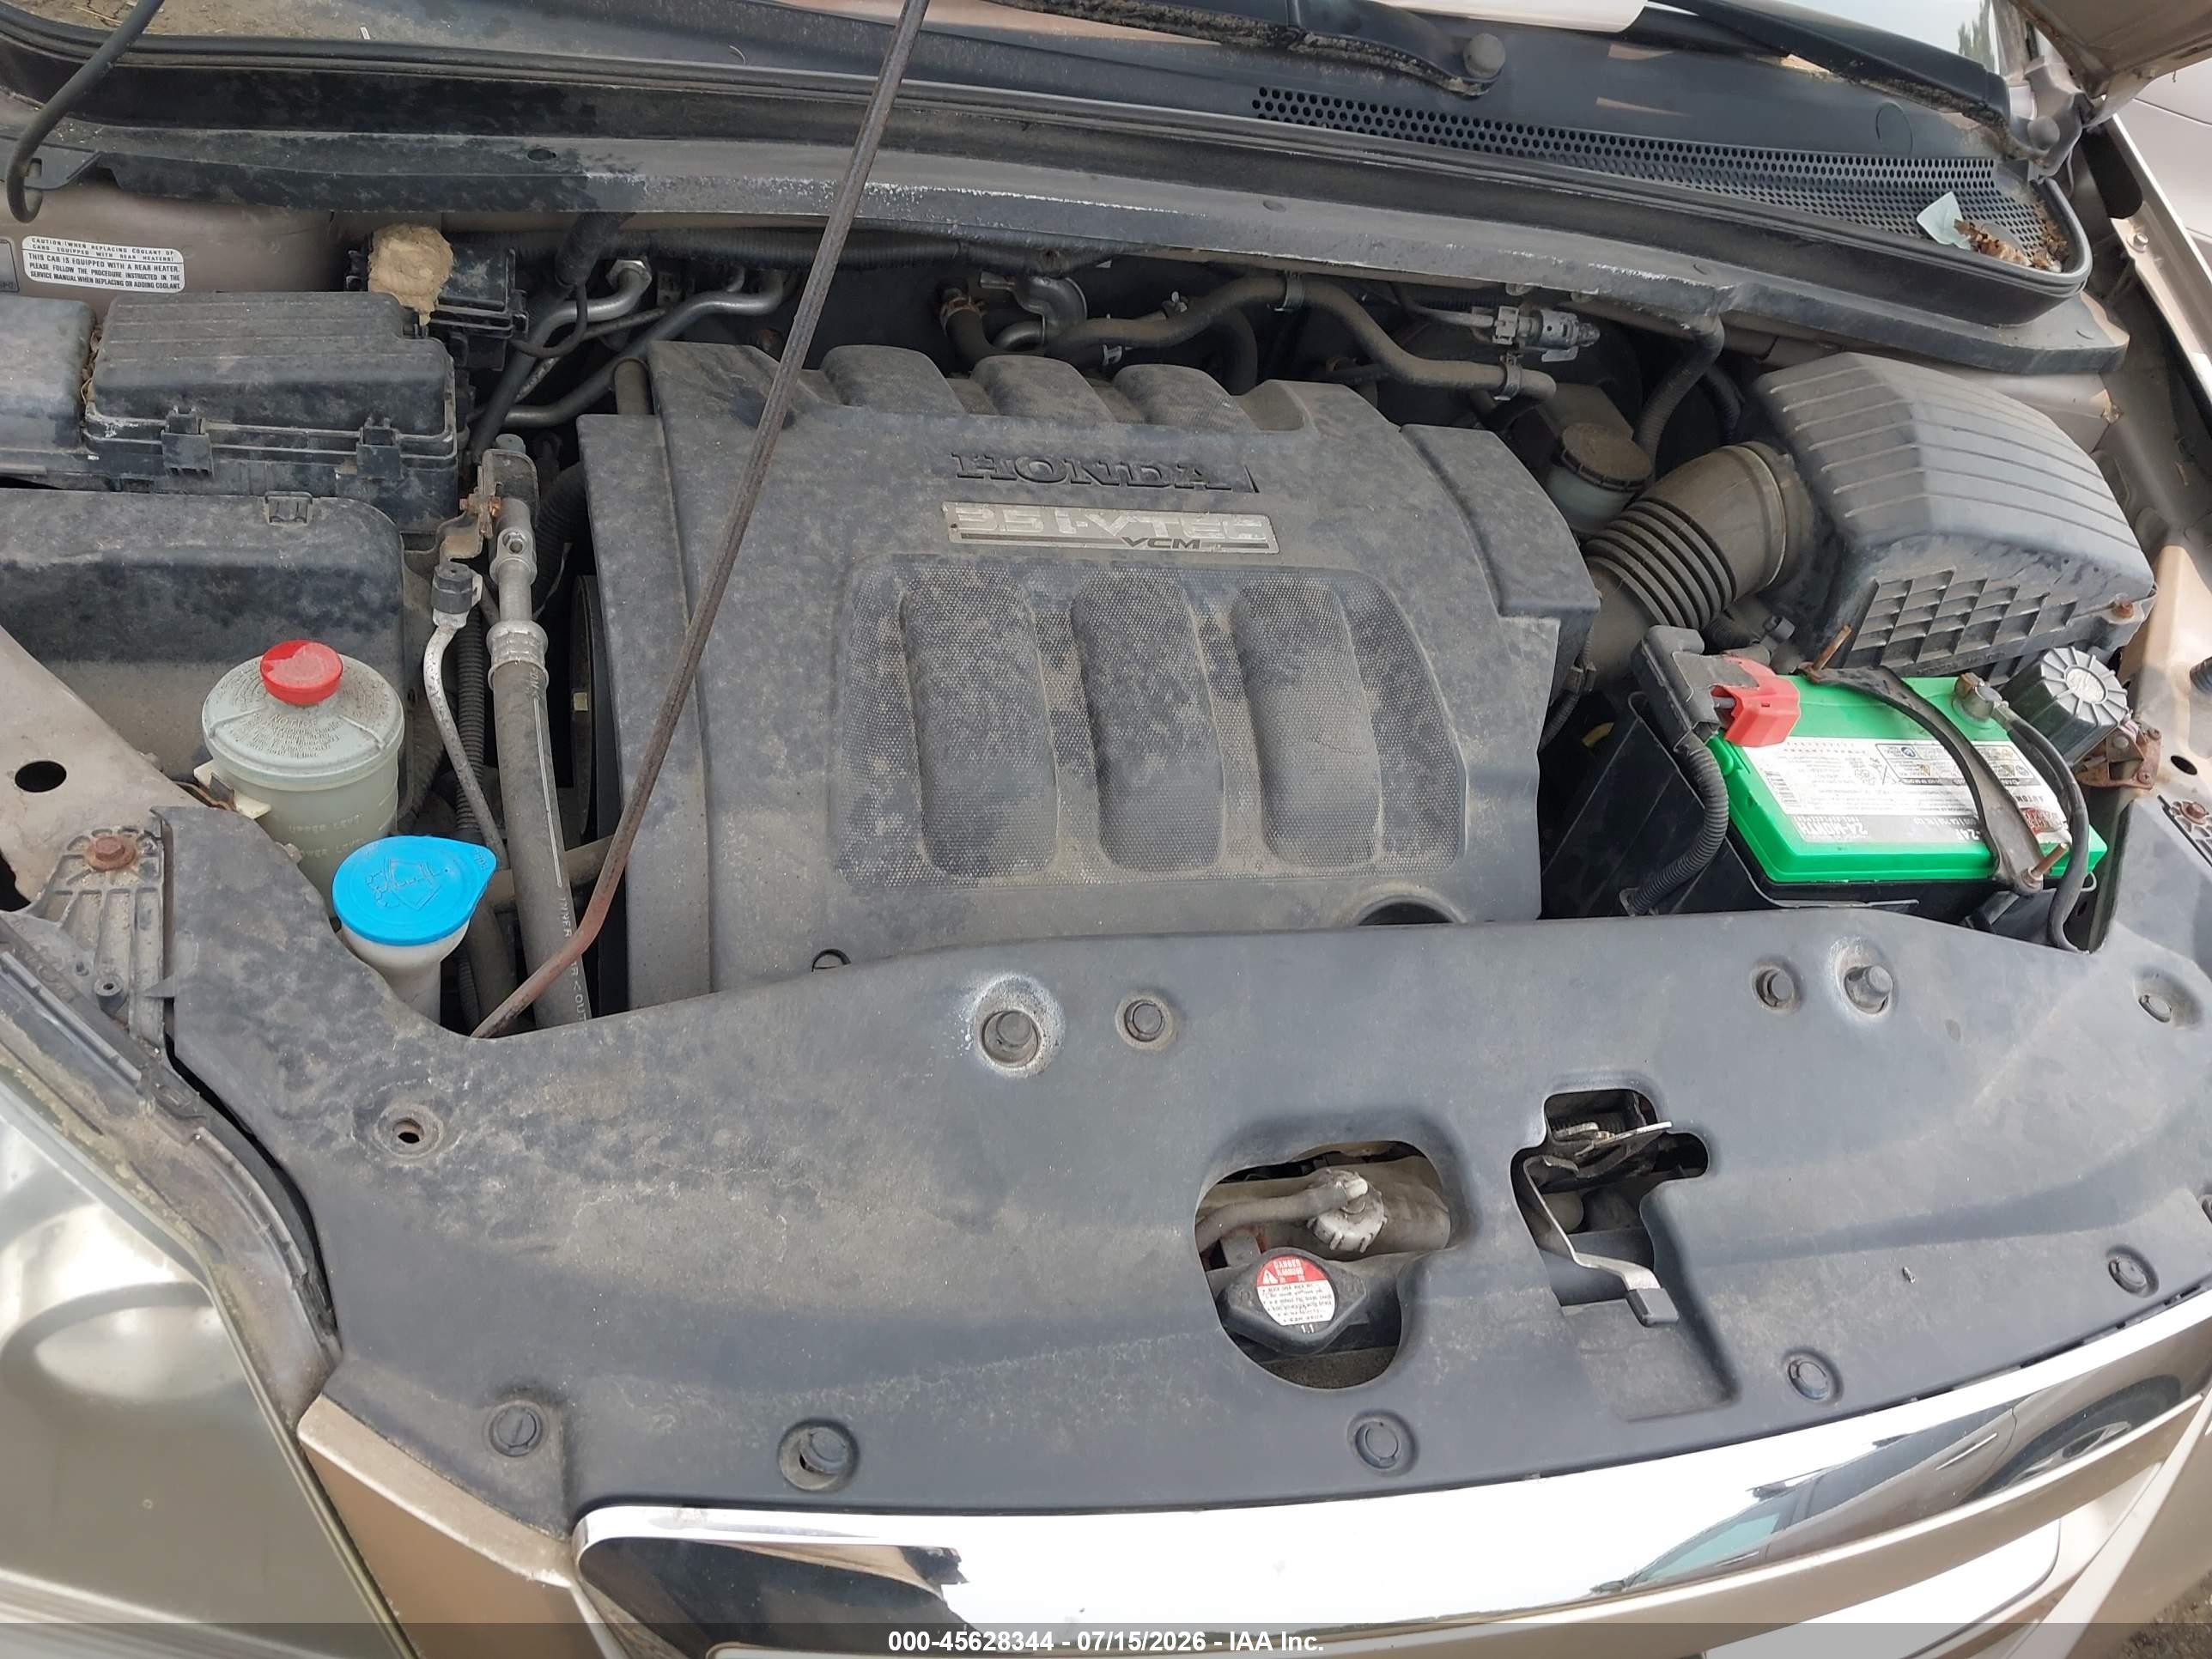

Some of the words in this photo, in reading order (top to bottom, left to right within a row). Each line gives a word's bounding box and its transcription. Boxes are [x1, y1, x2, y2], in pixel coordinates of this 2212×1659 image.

[28, 252, 45, 261] THIS
[72, 258, 105, 268] EQUIPPED
[29, 262, 50, 270] PLEASE
[52, 264, 75, 274] FOLLOW
[90, 269, 122, 278] PROCEDURE
[125, 272, 158, 281] INSTRUCTED
[30, 270, 52, 279] SERVICE
[53, 273, 76, 282] MANUAL
[94, 277, 125, 286] REPLACING
[951, 452, 1232, 491] HONDA
[1121, 536, 1200, 550] VCM
[270, 713, 318, 729] NOTICE
[1300, 1324, 1315, 1334] 1.1
